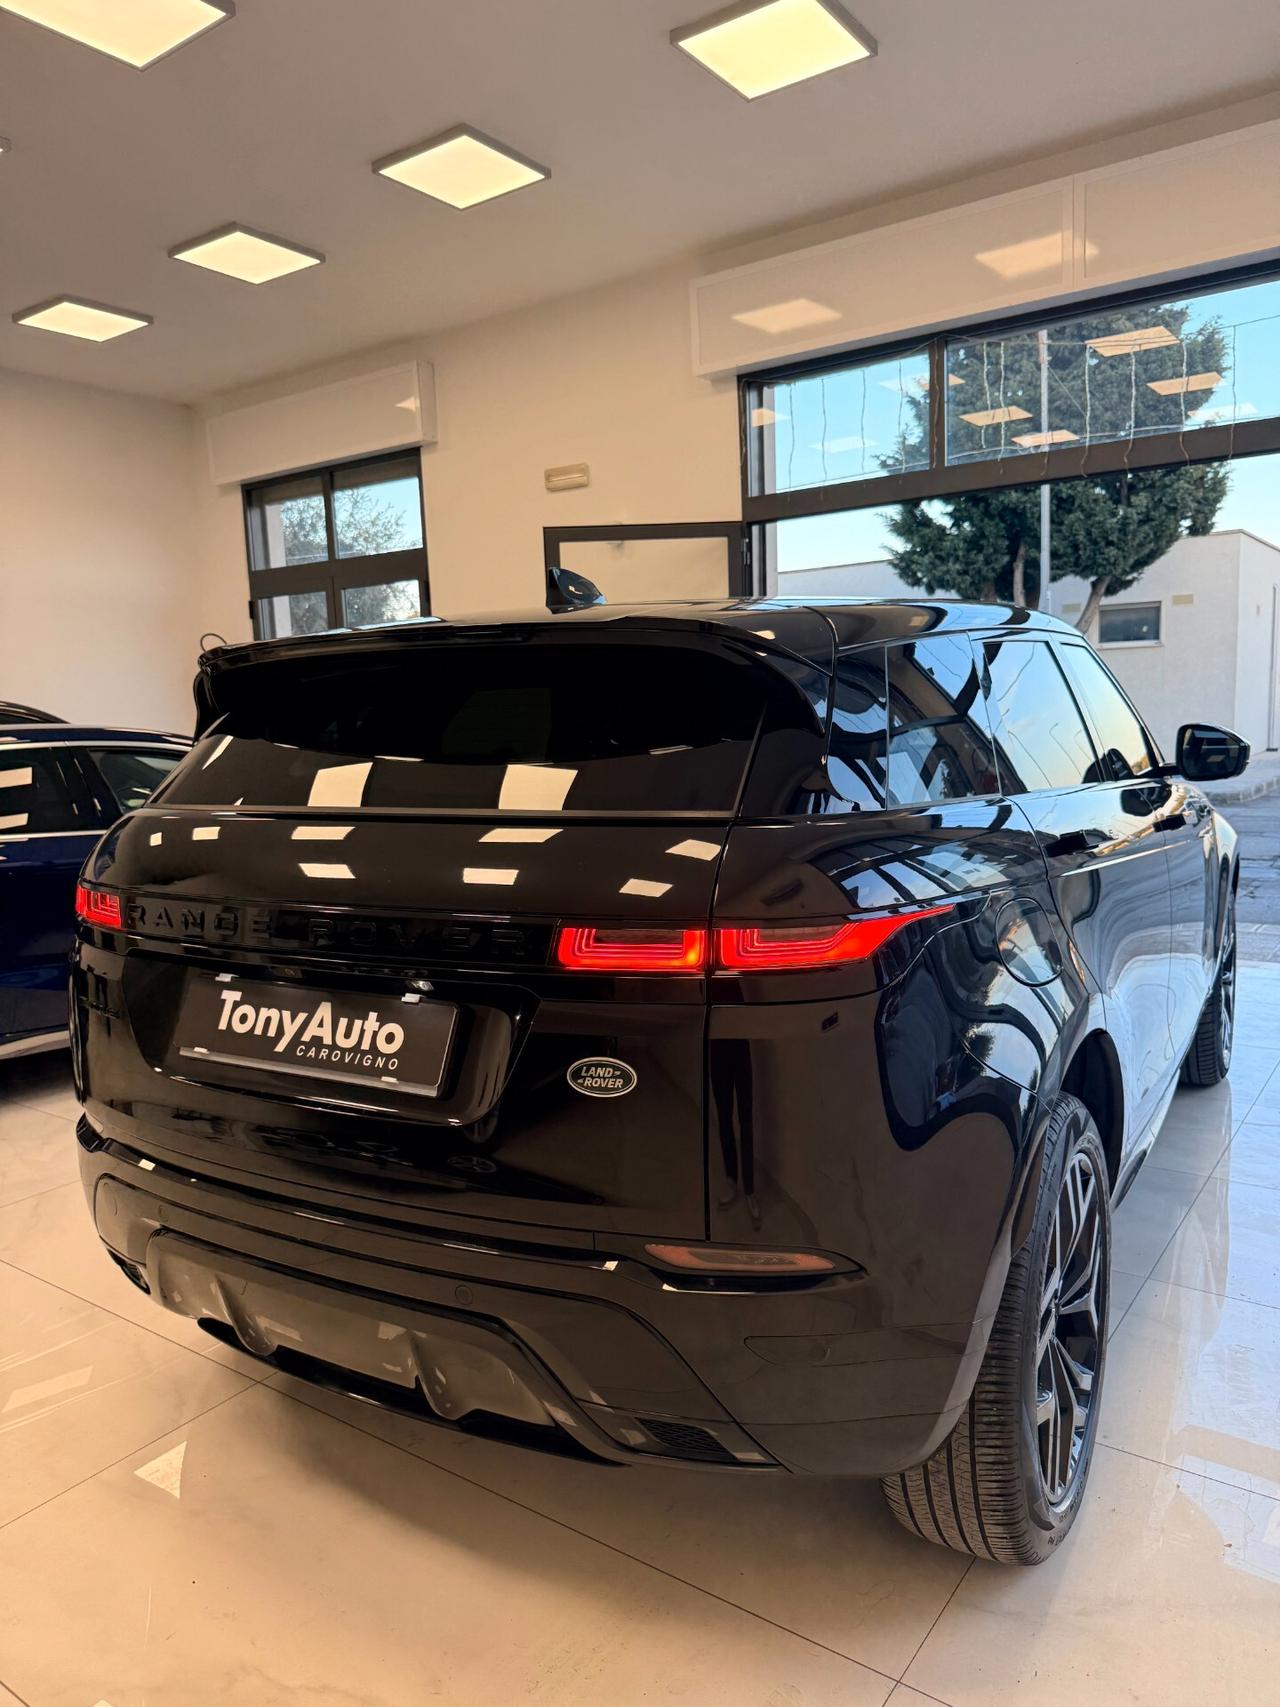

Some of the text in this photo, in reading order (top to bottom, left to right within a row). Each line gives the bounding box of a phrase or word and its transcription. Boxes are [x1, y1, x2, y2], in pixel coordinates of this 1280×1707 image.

[127, 903, 274, 939] RANGE
[218, 989, 405, 1054] TonyAuto
[296, 1045, 399, 1071] CAROVIGNO
[580, 1066, 613, 1078] LAND
[583, 1077, 624, 1088] ROVER
